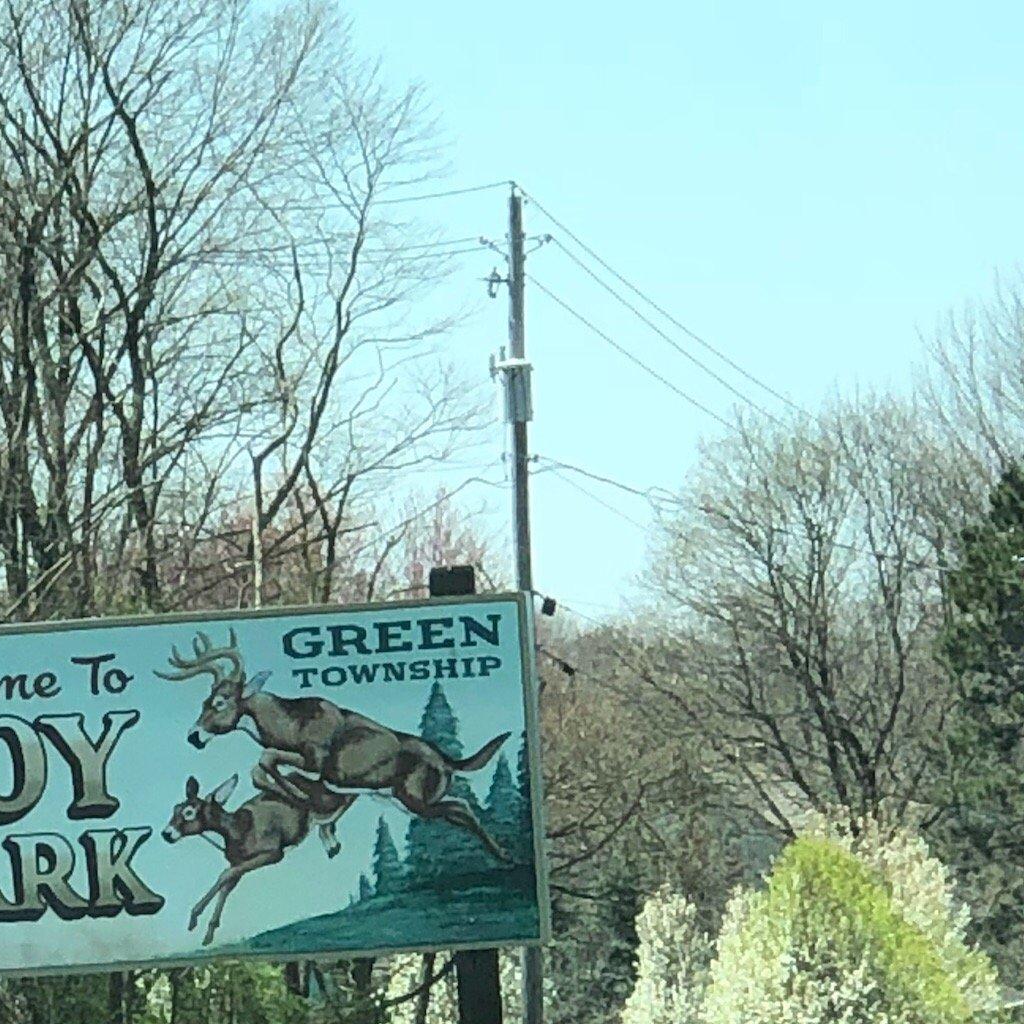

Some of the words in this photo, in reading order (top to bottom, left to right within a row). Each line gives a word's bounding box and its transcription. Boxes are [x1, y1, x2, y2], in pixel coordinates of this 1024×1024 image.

[282, 614, 502, 659] GREEN
[71, 653, 134, 695] To
[292, 656, 502, 689] TOWNSHIP
